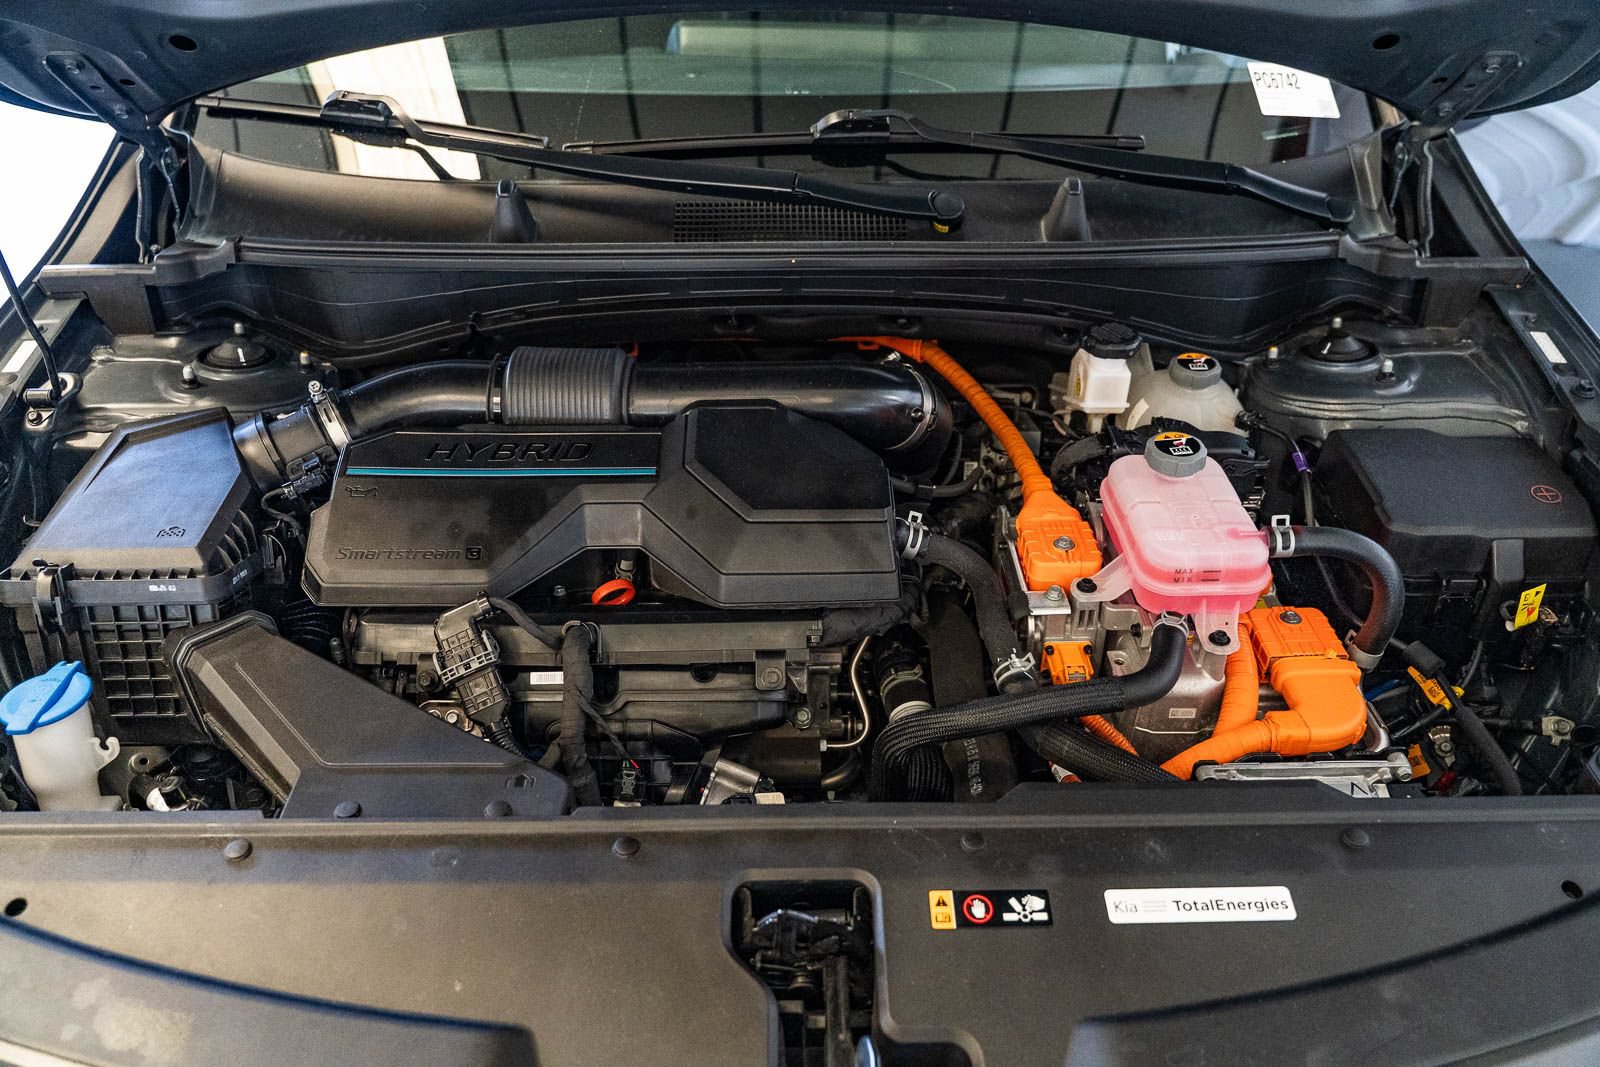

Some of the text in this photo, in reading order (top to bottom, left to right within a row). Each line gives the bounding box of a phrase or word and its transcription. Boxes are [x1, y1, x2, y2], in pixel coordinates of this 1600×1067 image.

[424, 441, 594, 462] HYBRID
[335, 546, 462, 560] Smartstream
[1113, 898, 1289, 913] Kia TotalEnergies
